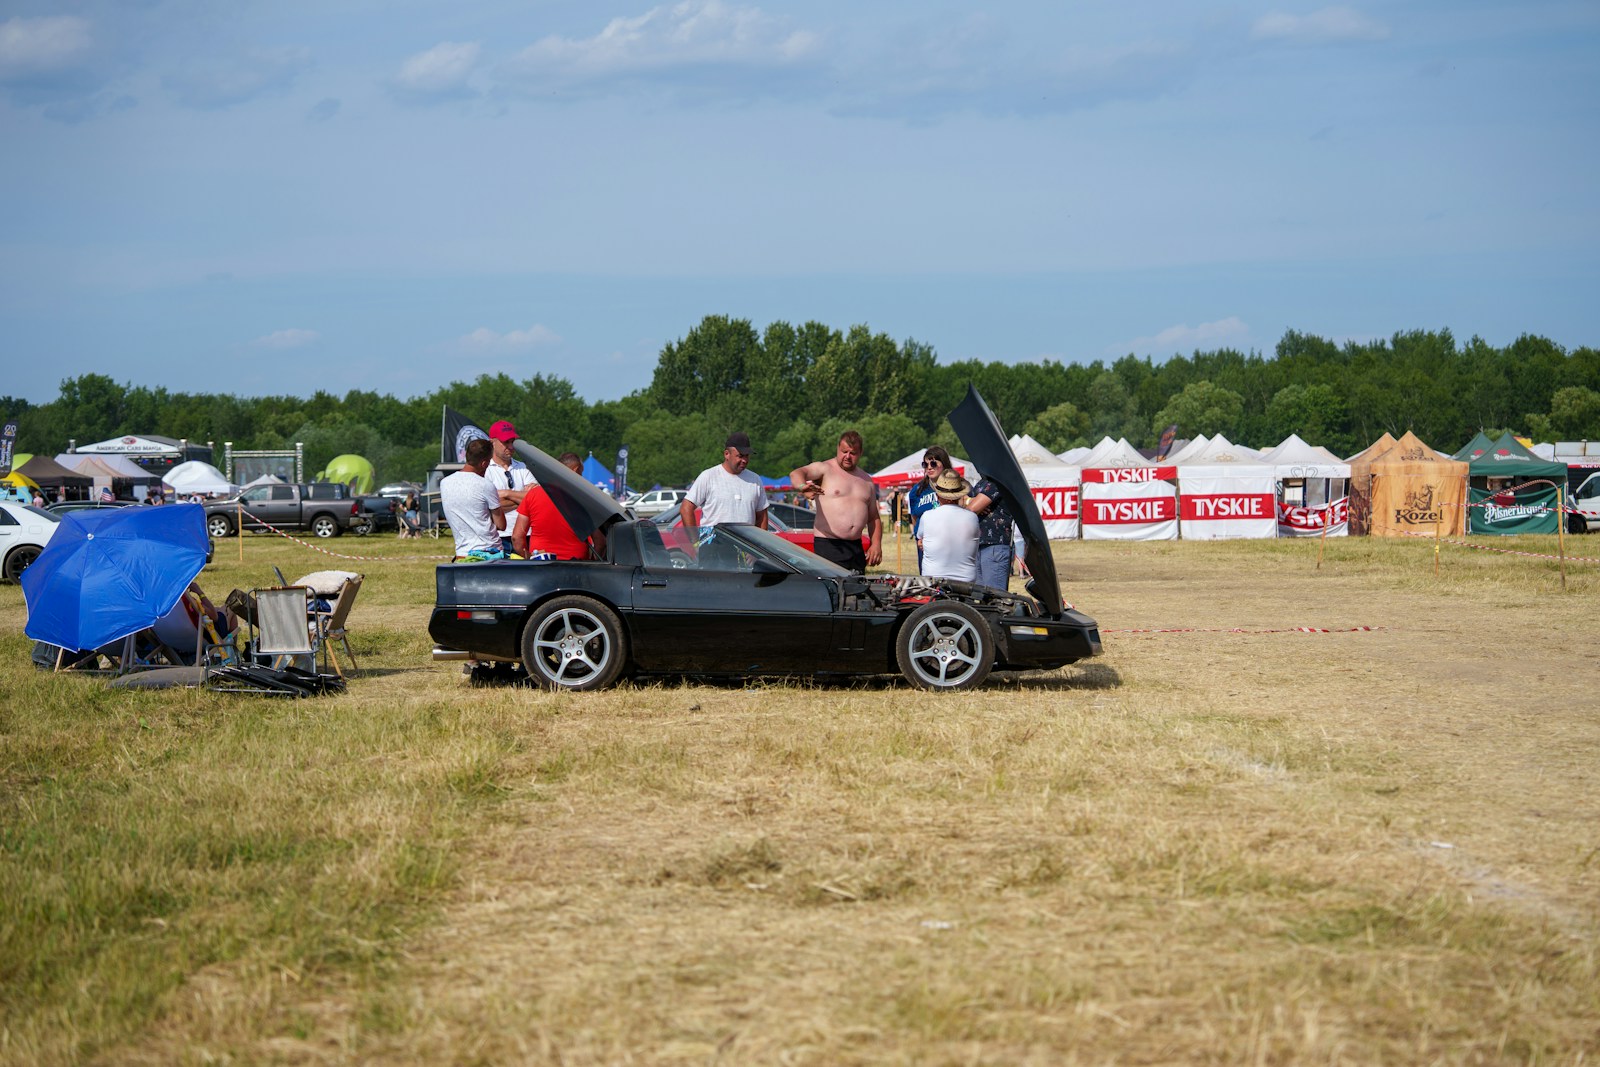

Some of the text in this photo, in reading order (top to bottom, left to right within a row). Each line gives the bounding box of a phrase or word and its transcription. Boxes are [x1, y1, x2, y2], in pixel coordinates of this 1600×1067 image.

[908, 469, 925, 478] TYSK
[1099, 468, 1158, 483] TYSKIE
[1033, 491, 1078, 516] KIE
[1093, 500, 1165, 521] TYSKIE
[1191, 497, 1263, 517] TYSKIE
[1278, 502, 1347, 527] YSKIE
[1394, 509, 1444, 525] Kozel
